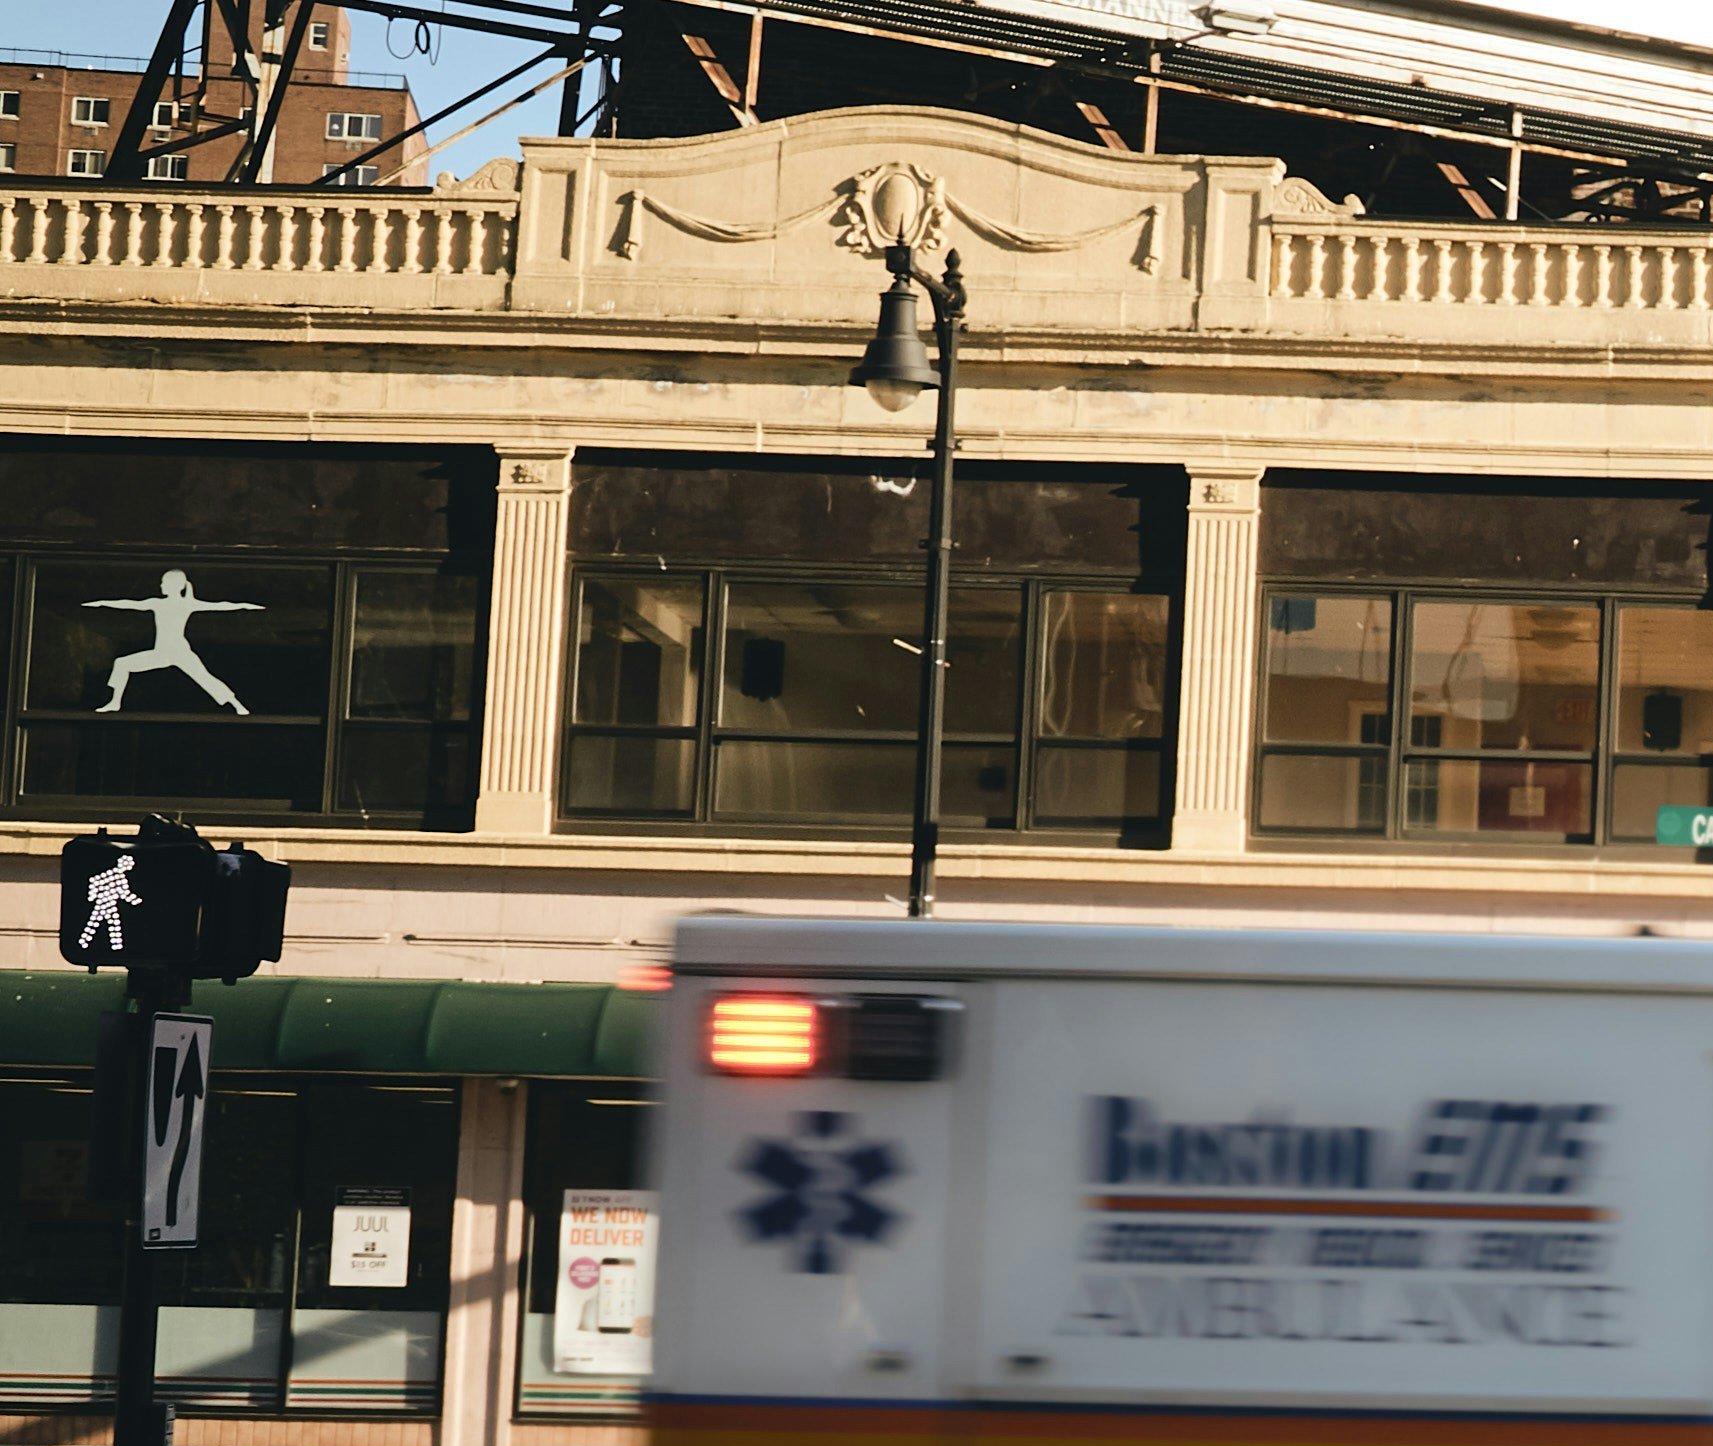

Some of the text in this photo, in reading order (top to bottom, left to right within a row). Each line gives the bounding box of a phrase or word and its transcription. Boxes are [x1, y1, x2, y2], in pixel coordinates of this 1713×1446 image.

[353, 1215, 389, 1233] JUUL
[571, 1206, 649, 1225] WE NOW
[569, 1228, 645, 1247] DELIVER
